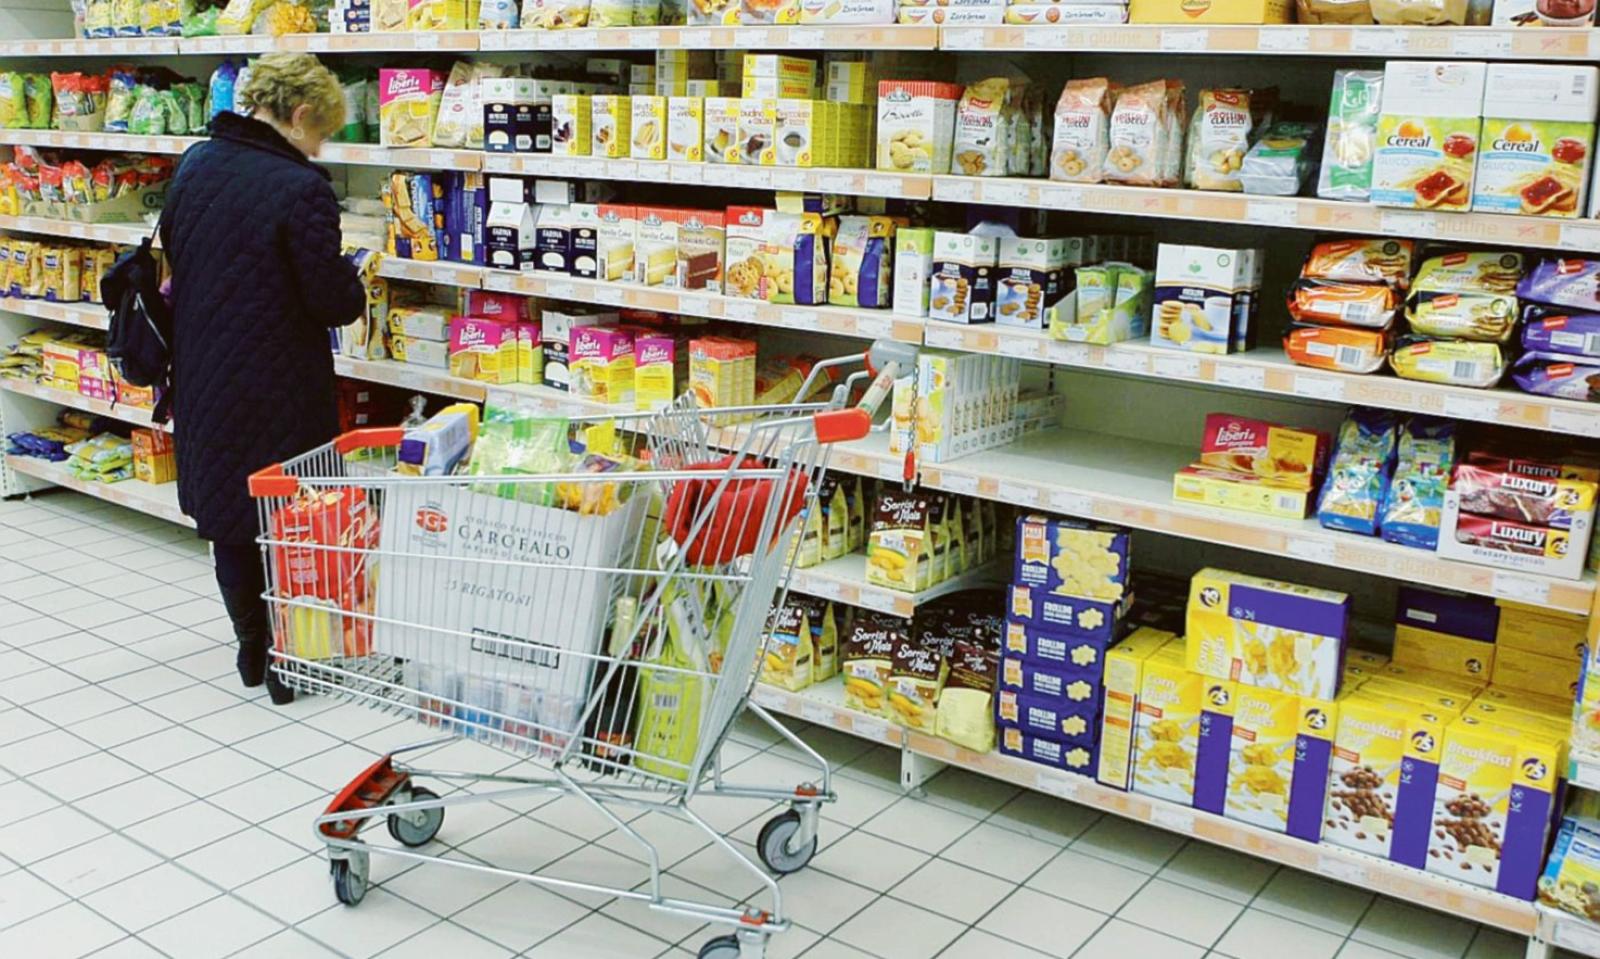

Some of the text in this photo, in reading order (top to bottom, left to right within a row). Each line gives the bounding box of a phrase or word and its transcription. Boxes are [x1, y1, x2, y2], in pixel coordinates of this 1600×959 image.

[1215, 426, 1248, 447] Liberi
[1501, 473, 1556, 498] Luxury
[457, 524, 571, 561] GAROFALO
[1490, 522, 1545, 550] Luxury
[460, 582, 533, 607] RIGATONI
[852, 627, 888, 644] Sorrisi
